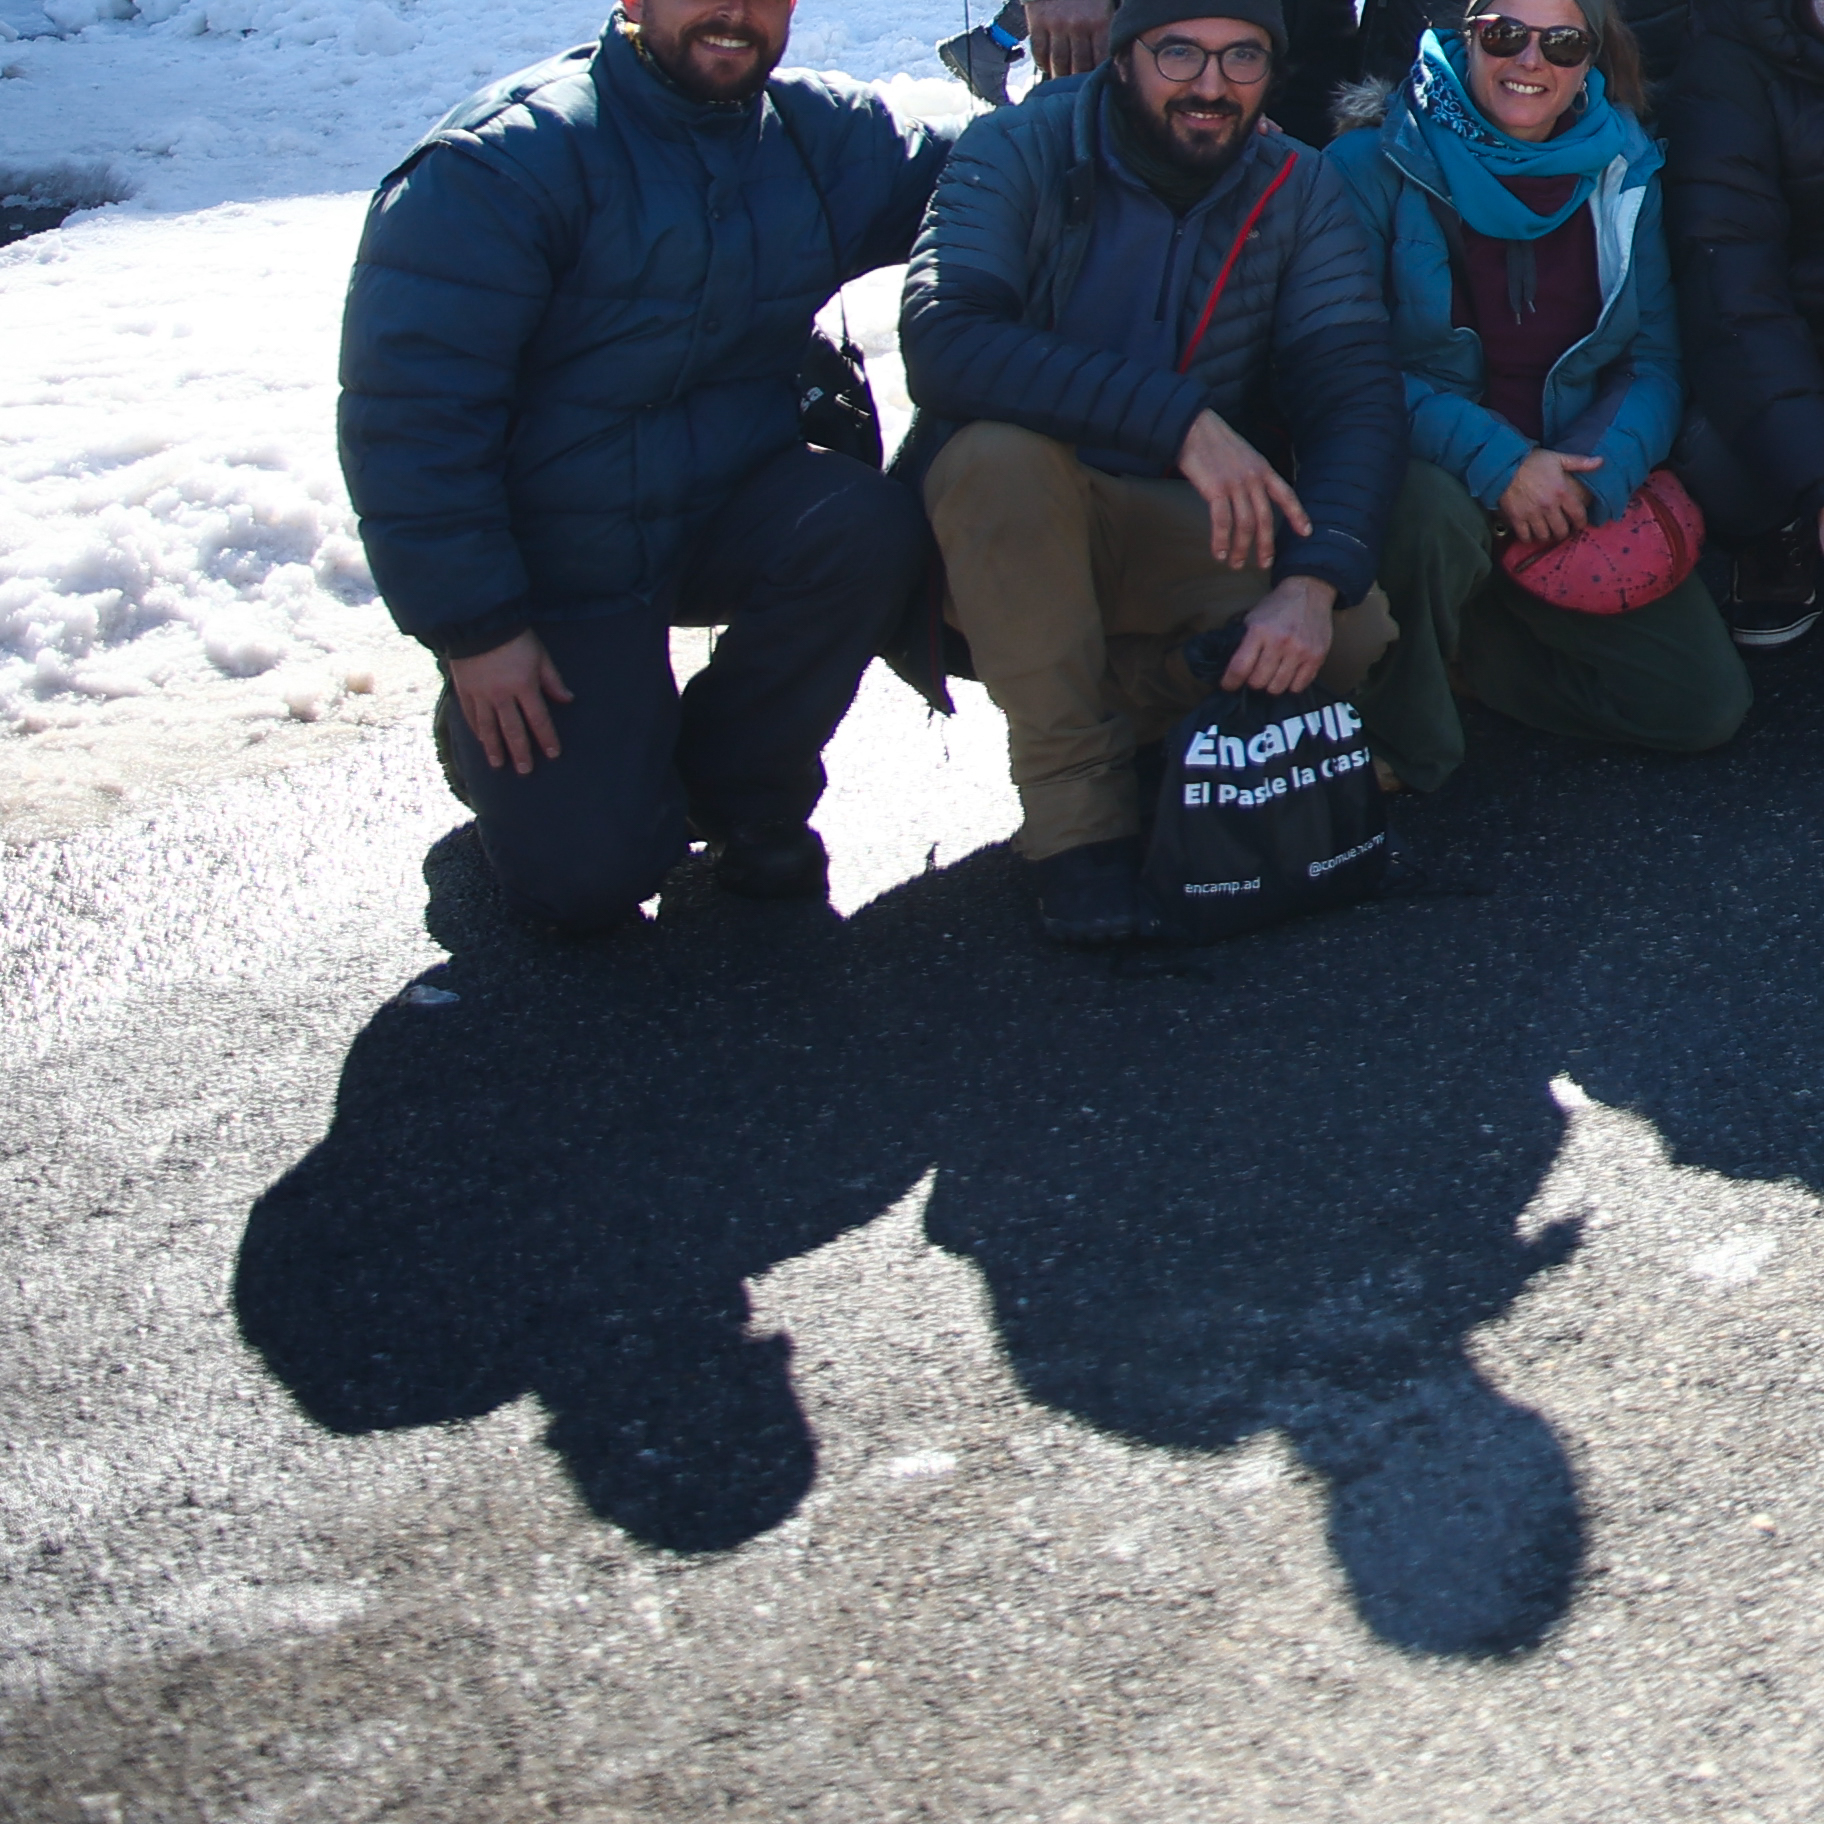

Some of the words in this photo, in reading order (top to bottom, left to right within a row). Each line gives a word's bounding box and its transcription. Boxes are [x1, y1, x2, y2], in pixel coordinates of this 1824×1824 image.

[1184, 782, 1211, 806] El
[1218, 783, 1266, 807] Pas
[1291, 766, 1316, 788] la
[1184, 876, 1261, 895] encamp.ad
